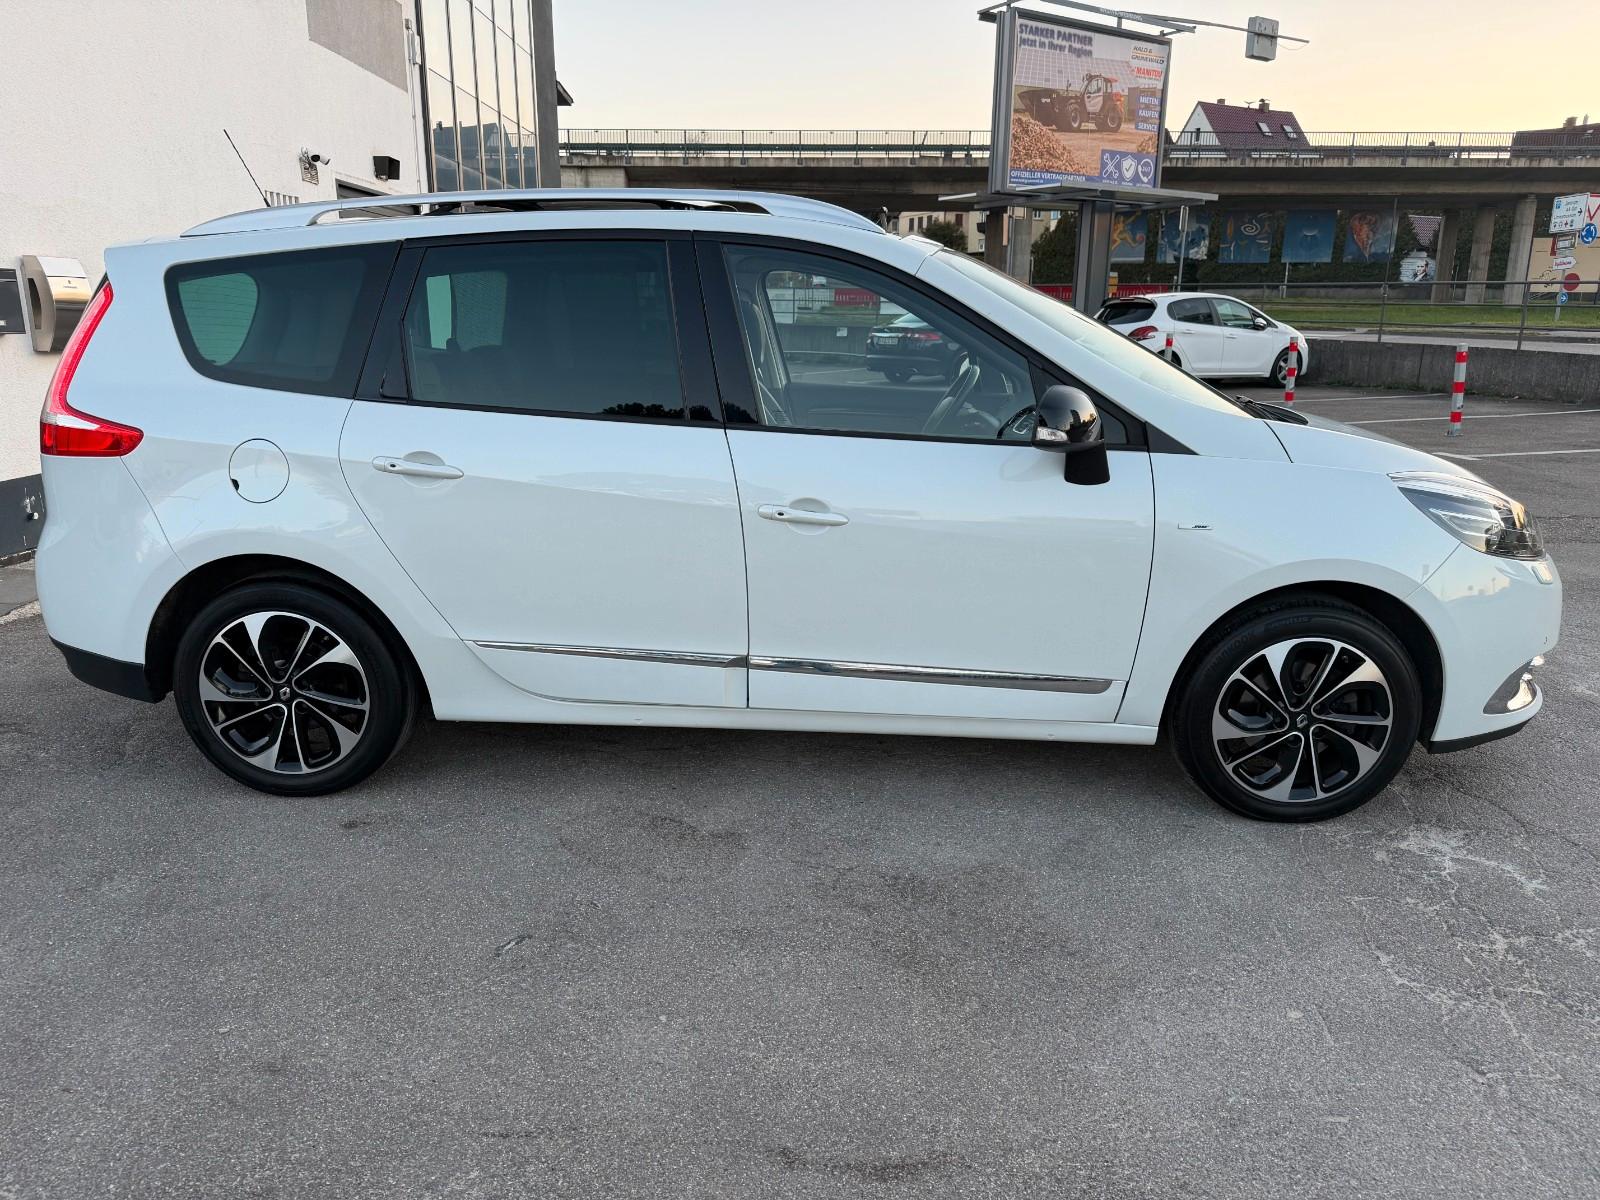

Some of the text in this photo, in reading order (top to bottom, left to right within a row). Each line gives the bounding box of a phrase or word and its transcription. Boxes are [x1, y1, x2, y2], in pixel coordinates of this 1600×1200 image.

[1019, 23, 1093, 46] STARKER PARTNER
[1039, 38, 1046, 49] in
[1048, 40, 1066, 53] Ihrer
[1068, 43, 1093, 58] Region
[1136, 66, 1163, 77] MANITOU
[1140, 96, 1159, 105] MIETEN
[1138, 109, 1159, 118] KAUFEN
[1137, 123, 1158, 131] SERVICE
[1011, 171, 1041, 179] OFFIZIELLER
[1042, 173, 1086, 181] VERTRAGSPARTNER
